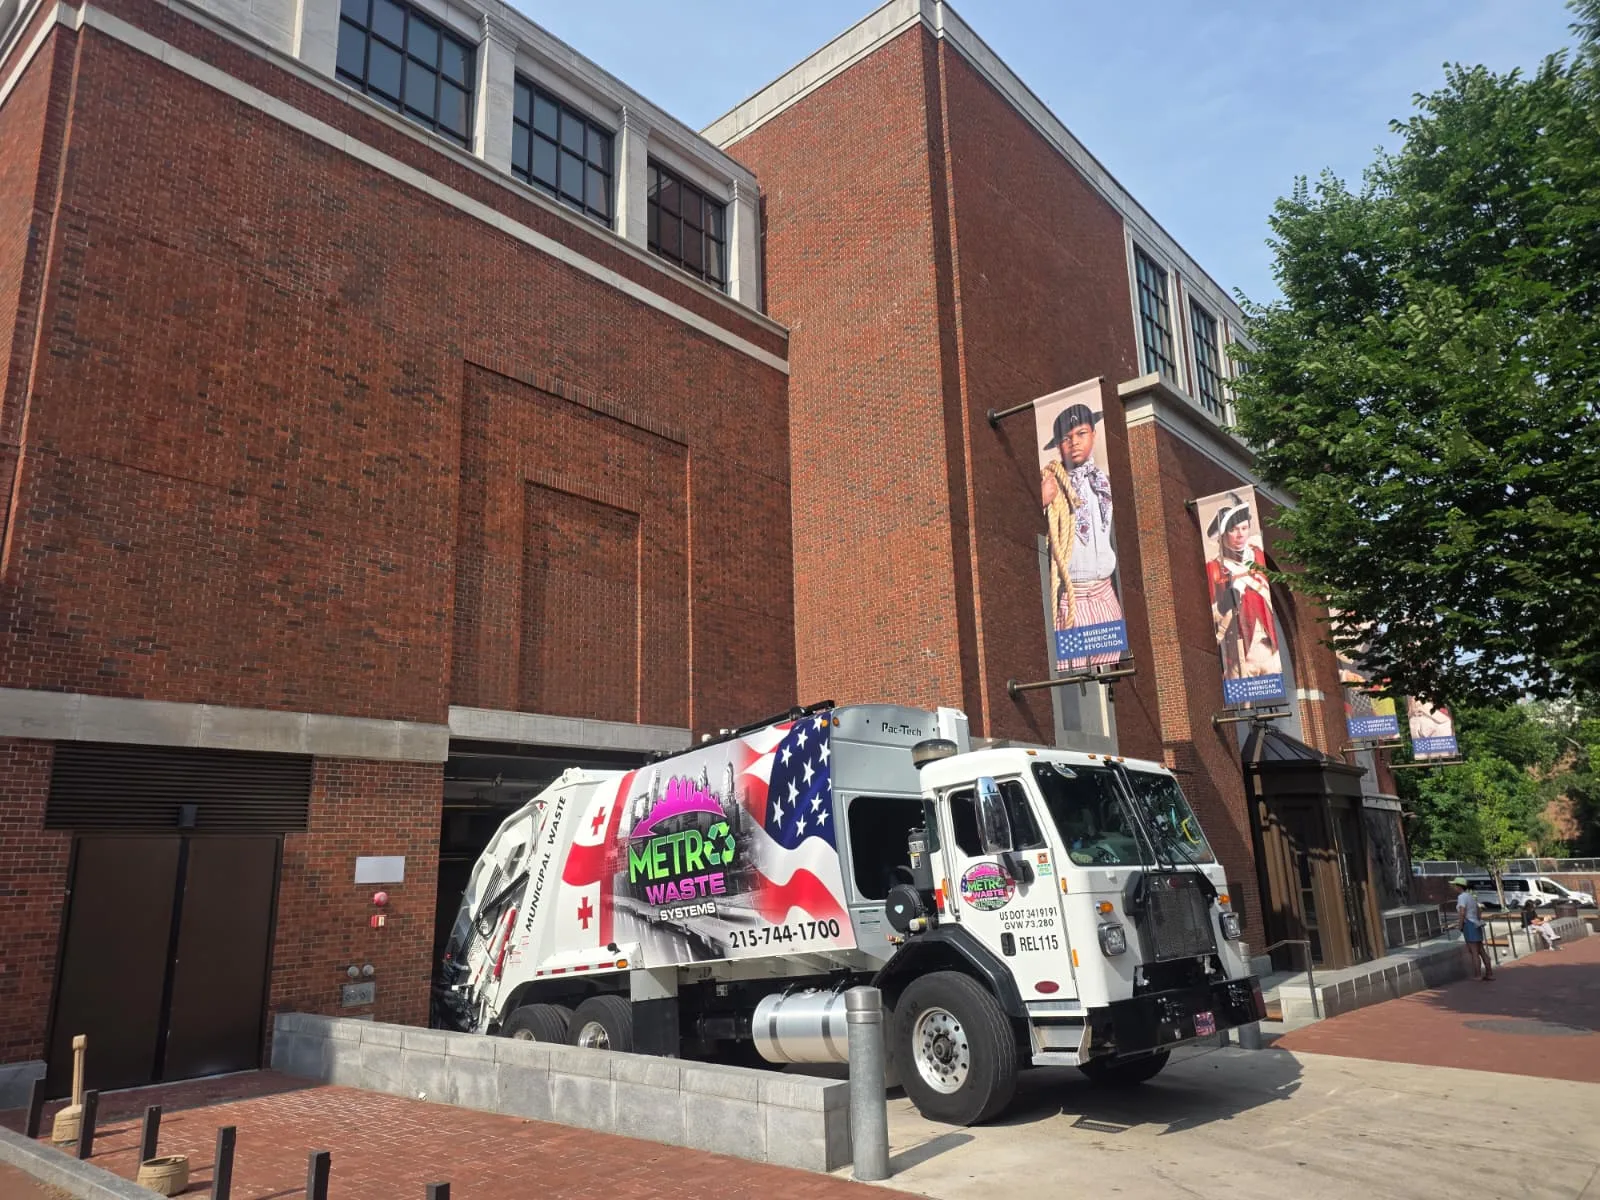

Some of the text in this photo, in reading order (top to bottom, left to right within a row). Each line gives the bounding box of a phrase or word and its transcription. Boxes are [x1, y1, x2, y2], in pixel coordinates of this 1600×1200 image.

[1083, 627, 1108, 637] MUSEUM
[1084, 633, 1117, 643] AMERICAN
[1085, 640, 1123, 651] REVOLUTION
[1248, 689, 1282, 697] REVOLUTION
[882, 722, 922, 737] Pac-Tech
[525, 796, 566, 932] MUNICIPAL WASTE
[645, 872, 727, 906] WASTE
[972, 888, 1005, 899] WASTE
[660, 902, 717, 921] SYSTEMS
[1026, 906, 1058, 919] 3419191
[1004, 921, 1024, 930] GVW
[729, 918, 840, 949] 215-744-1700
[1019, 934, 1059, 952] REL115
